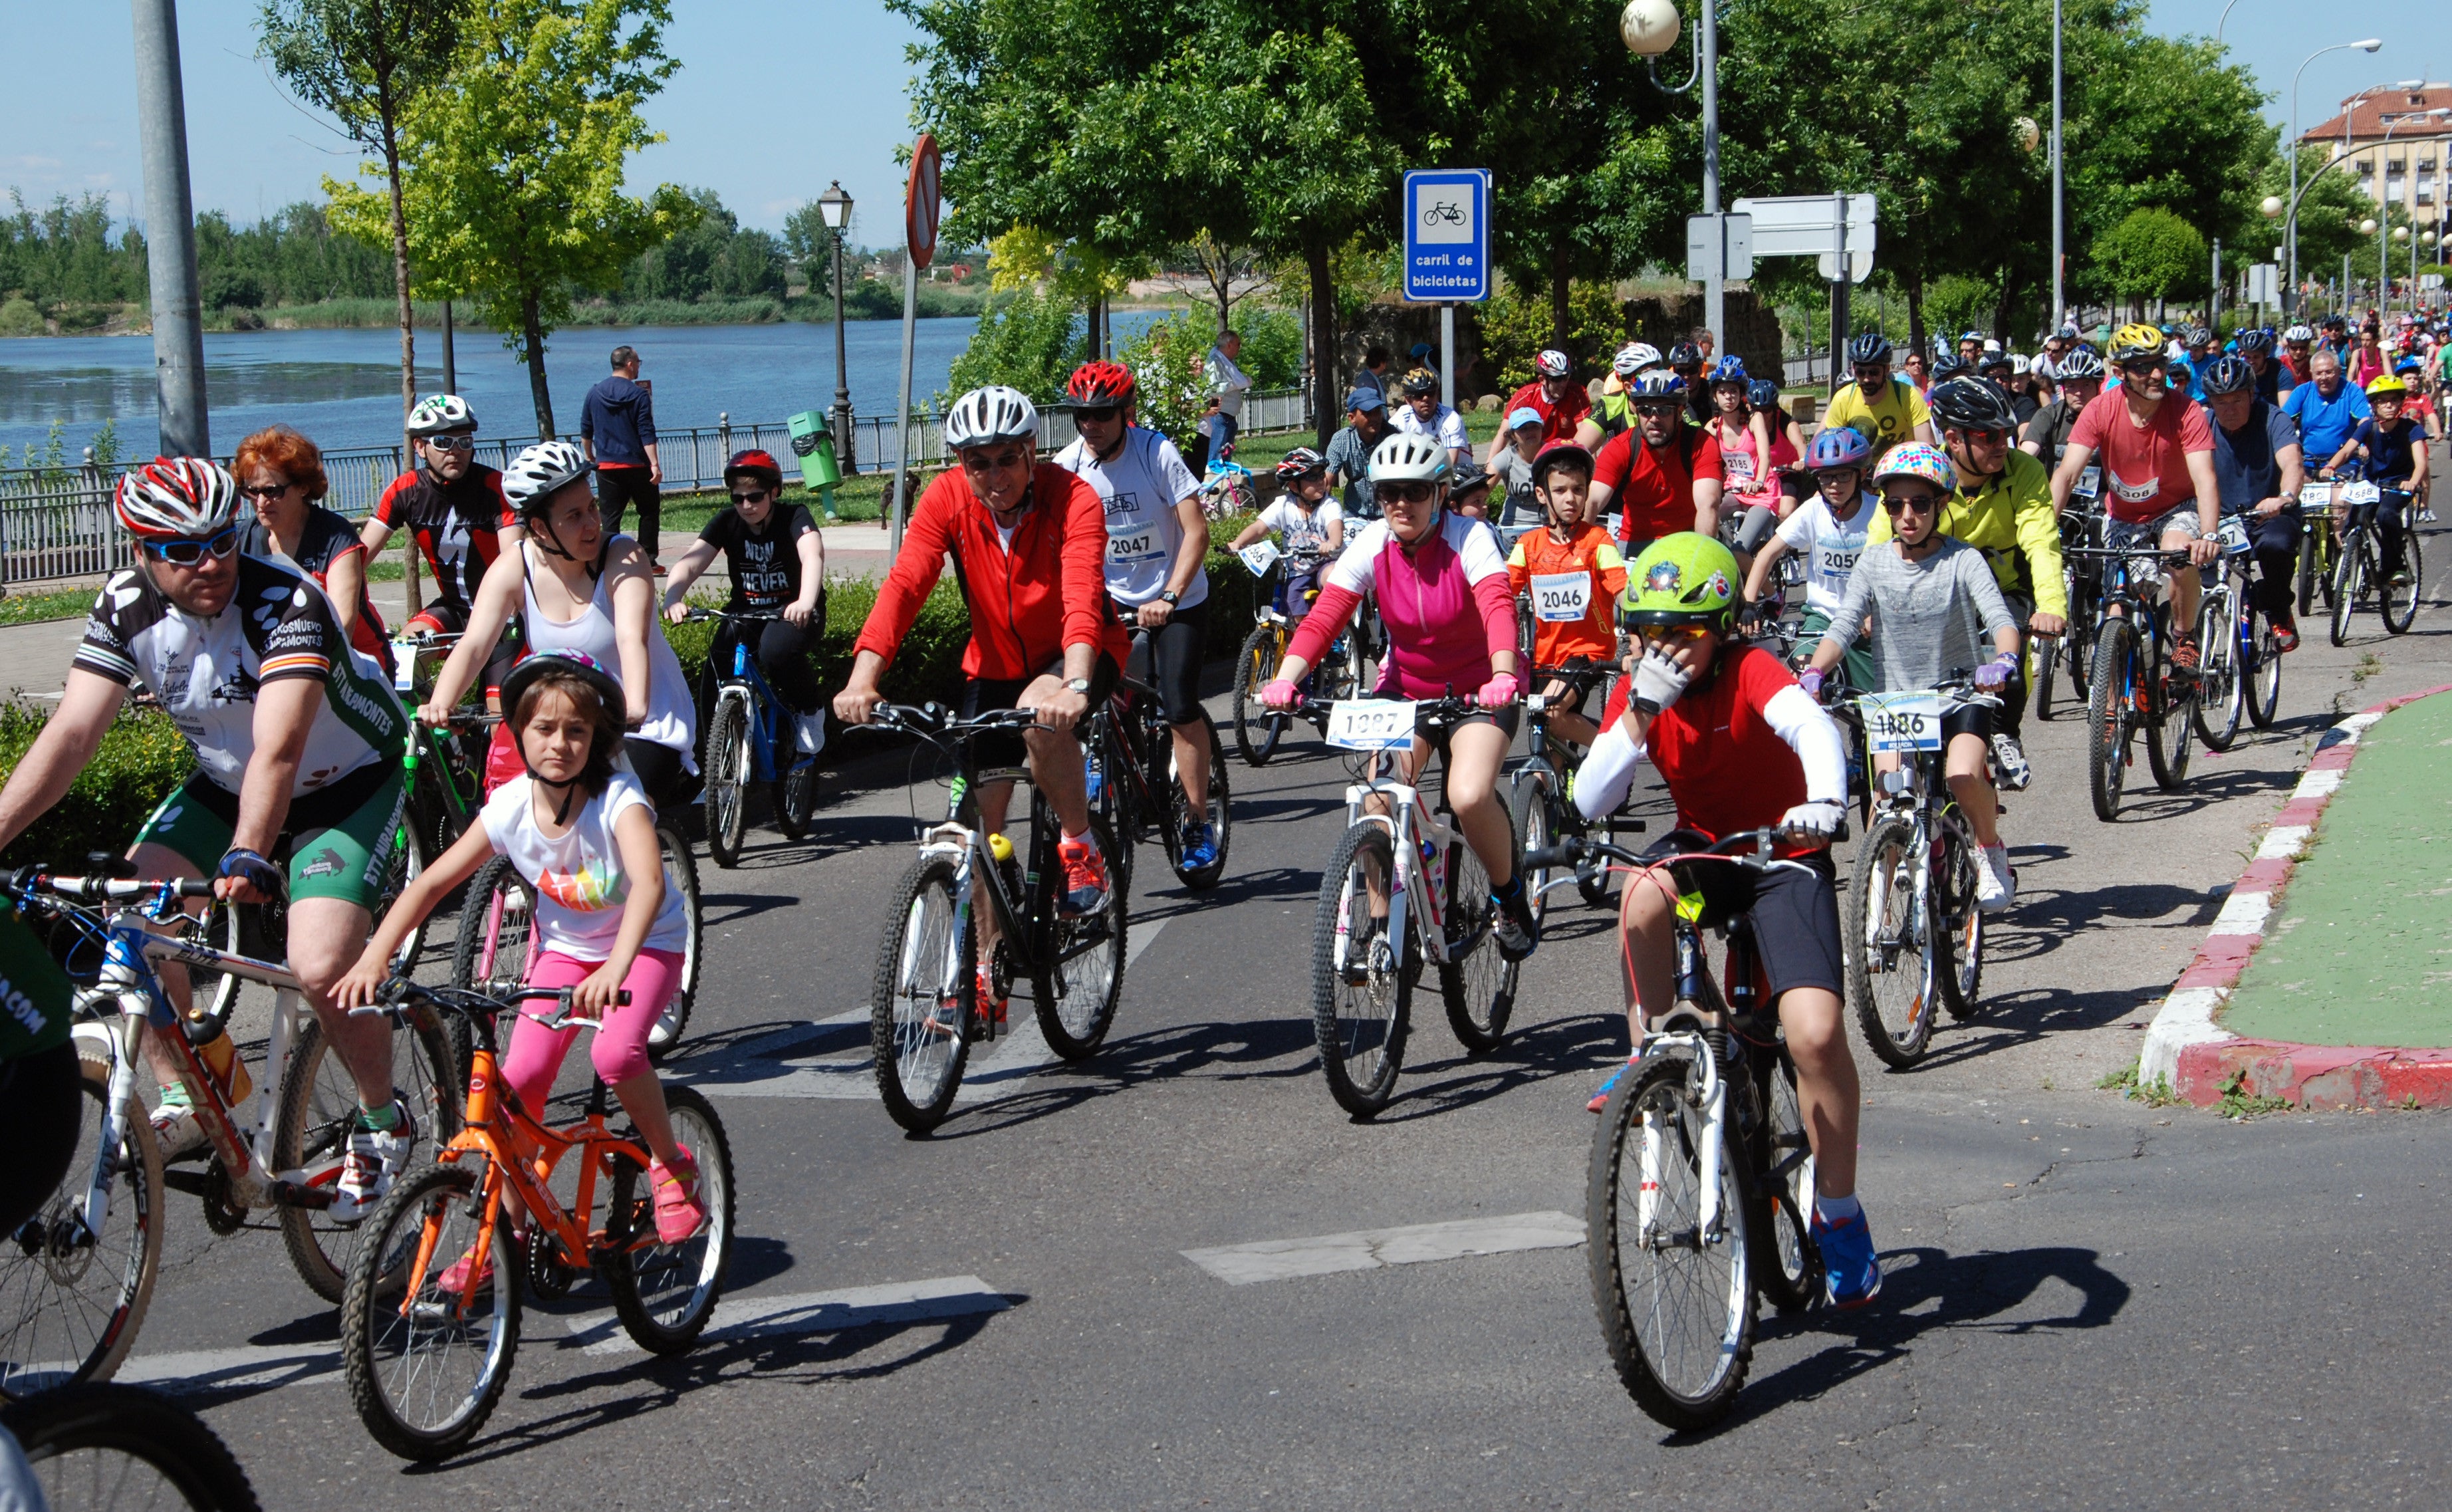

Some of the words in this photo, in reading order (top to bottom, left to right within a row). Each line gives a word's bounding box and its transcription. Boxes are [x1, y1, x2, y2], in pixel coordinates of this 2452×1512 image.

[1416, 254, 1450, 265] carril
[1457, 255, 1473, 265] de
[1413, 275, 1477, 287] bicicletas
[1728, 459, 1748, 469] 2185
[745, 540, 774, 562] NOW
[1112, 535, 1149, 554] 2047
[741, 571, 789, 592] NEVER
[1542, 590, 1582, 608] 2046
[1878, 713, 1925, 735] 1886
[363, 854, 384, 887] BTT
[521, 1158, 562, 1223] ORBEA
